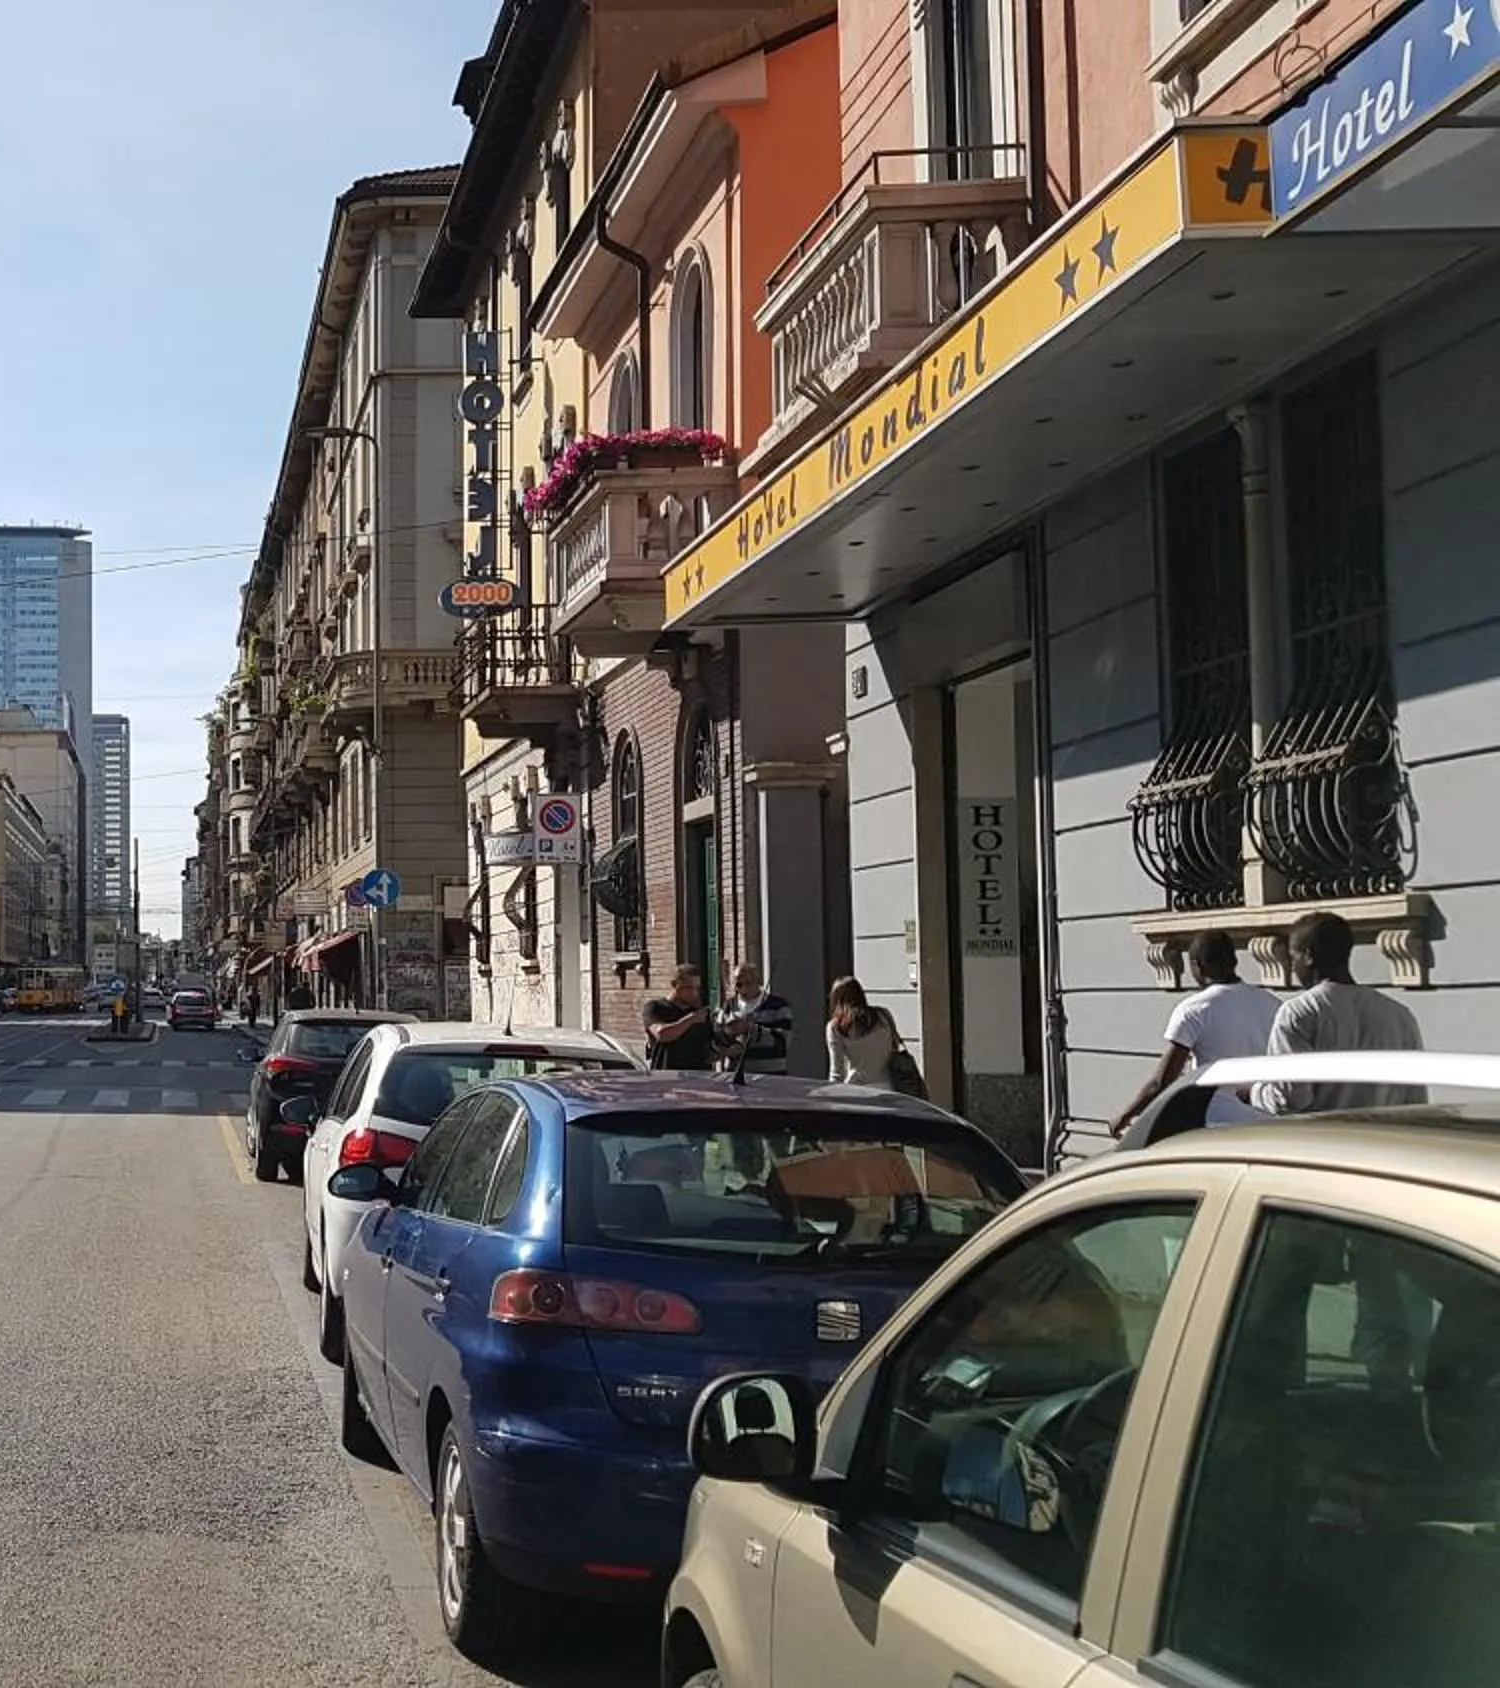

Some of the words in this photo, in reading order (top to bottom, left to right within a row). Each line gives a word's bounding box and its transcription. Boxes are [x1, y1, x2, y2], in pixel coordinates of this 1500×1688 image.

[1288, 39, 1415, 201] Hotel
[738, 473, 797, 561] Hotel
[829, 315, 987, 490] Mondial
[452, 582, 513, 606] 2000
[970, 805, 1005, 926] HOTEL
[966, 939, 1014, 951] MONDIAL
[617, 1385, 681, 1400] SEAT
